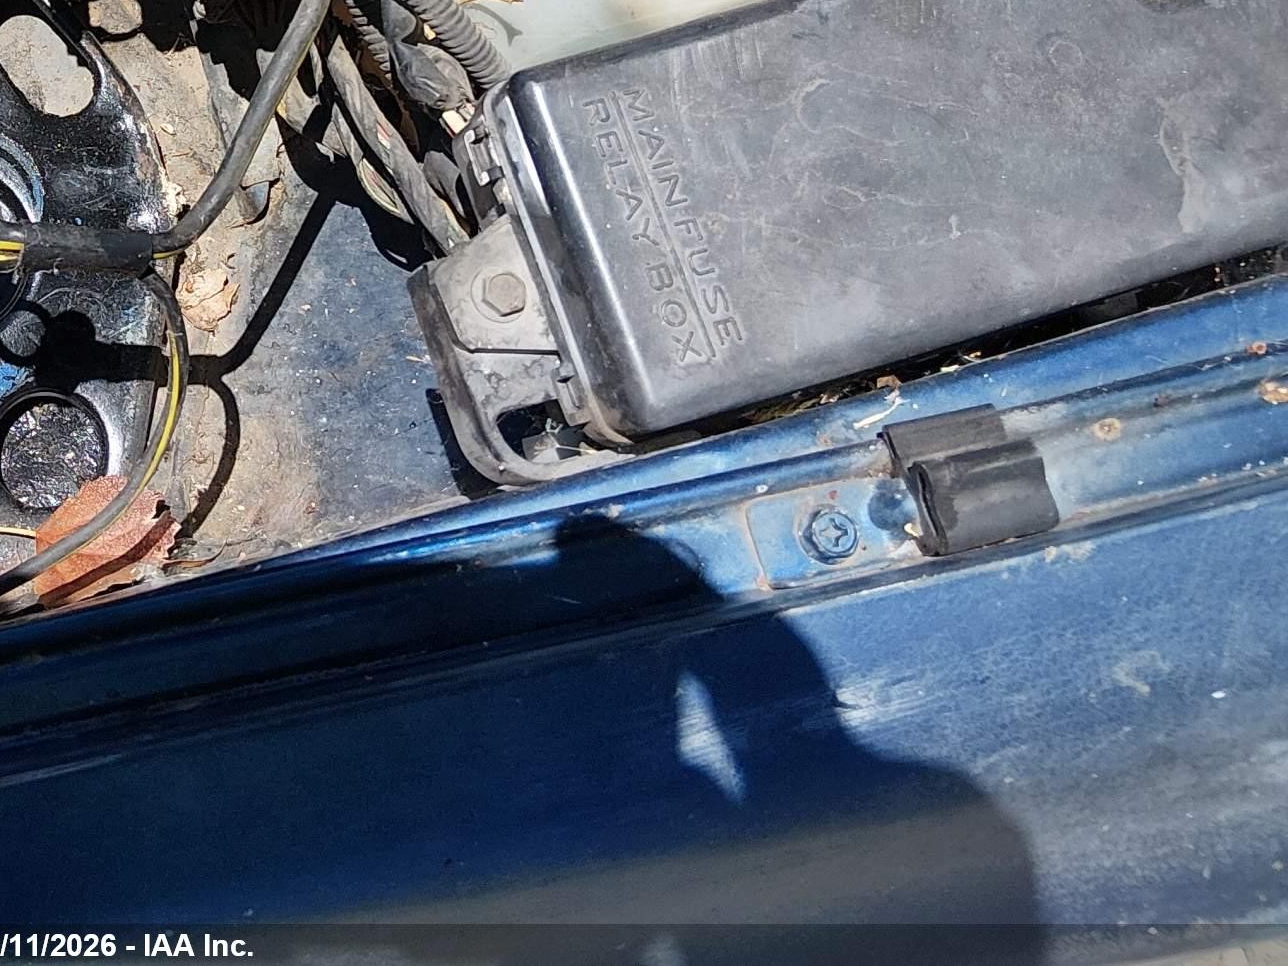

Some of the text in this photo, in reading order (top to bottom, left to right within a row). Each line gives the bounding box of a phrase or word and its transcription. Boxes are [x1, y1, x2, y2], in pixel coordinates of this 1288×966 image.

[582, 97, 703, 363] RELAY BOX
[622, 88, 743, 346] MAIN FUSE
